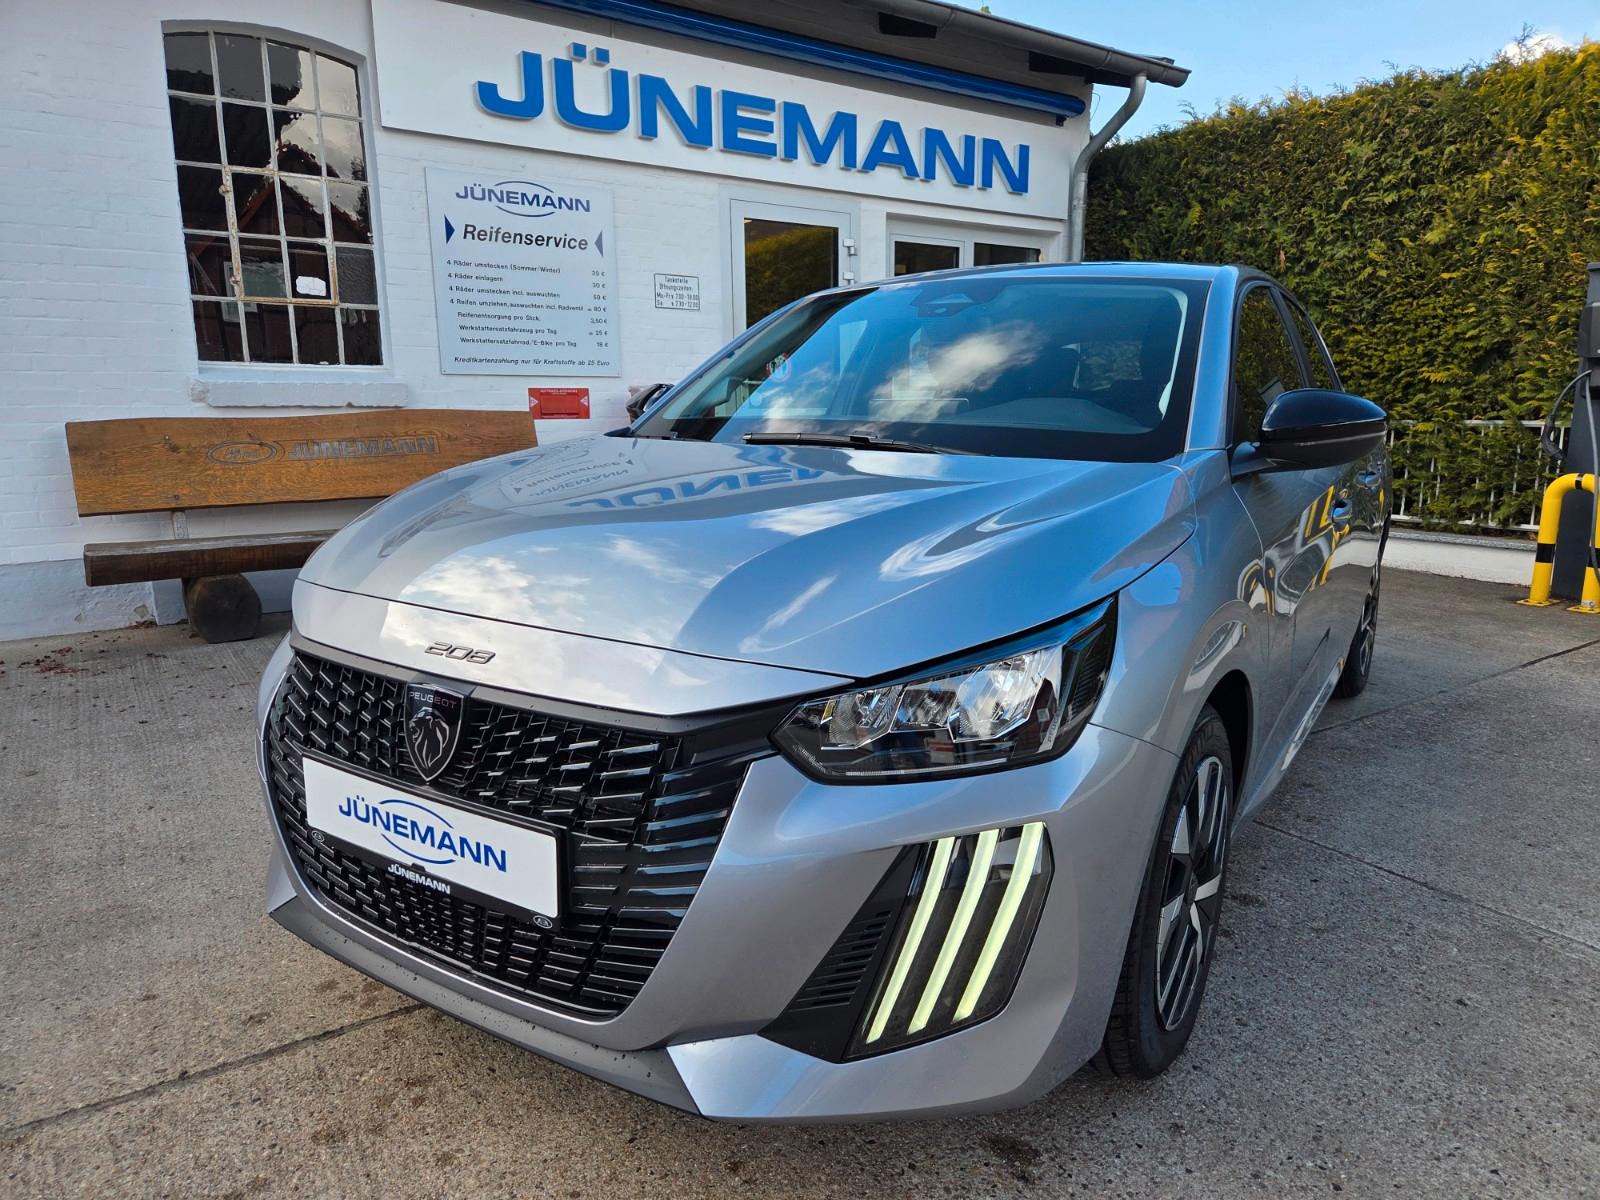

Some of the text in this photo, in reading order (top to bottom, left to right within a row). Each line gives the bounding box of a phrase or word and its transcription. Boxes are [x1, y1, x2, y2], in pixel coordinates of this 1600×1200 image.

[474, 42, 1031, 195] JÜNEMANN
[456, 183, 591, 213] JÜNEMANN
[463, 223, 589, 251] Reifenservice
[456, 285, 474, 293] Räder
[476, 274, 504, 282] einlagern
[457, 311, 512, 321] Reifenentsorgung
[454, 356, 519, 366] Kreditkartenzahlung
[424, 641, 497, 665] 208
[409, 691, 457, 709] PEUGEOT
[338, 795, 507, 872] JÜNEMANN
[387, 863, 451, 895] JÜNEMANN
